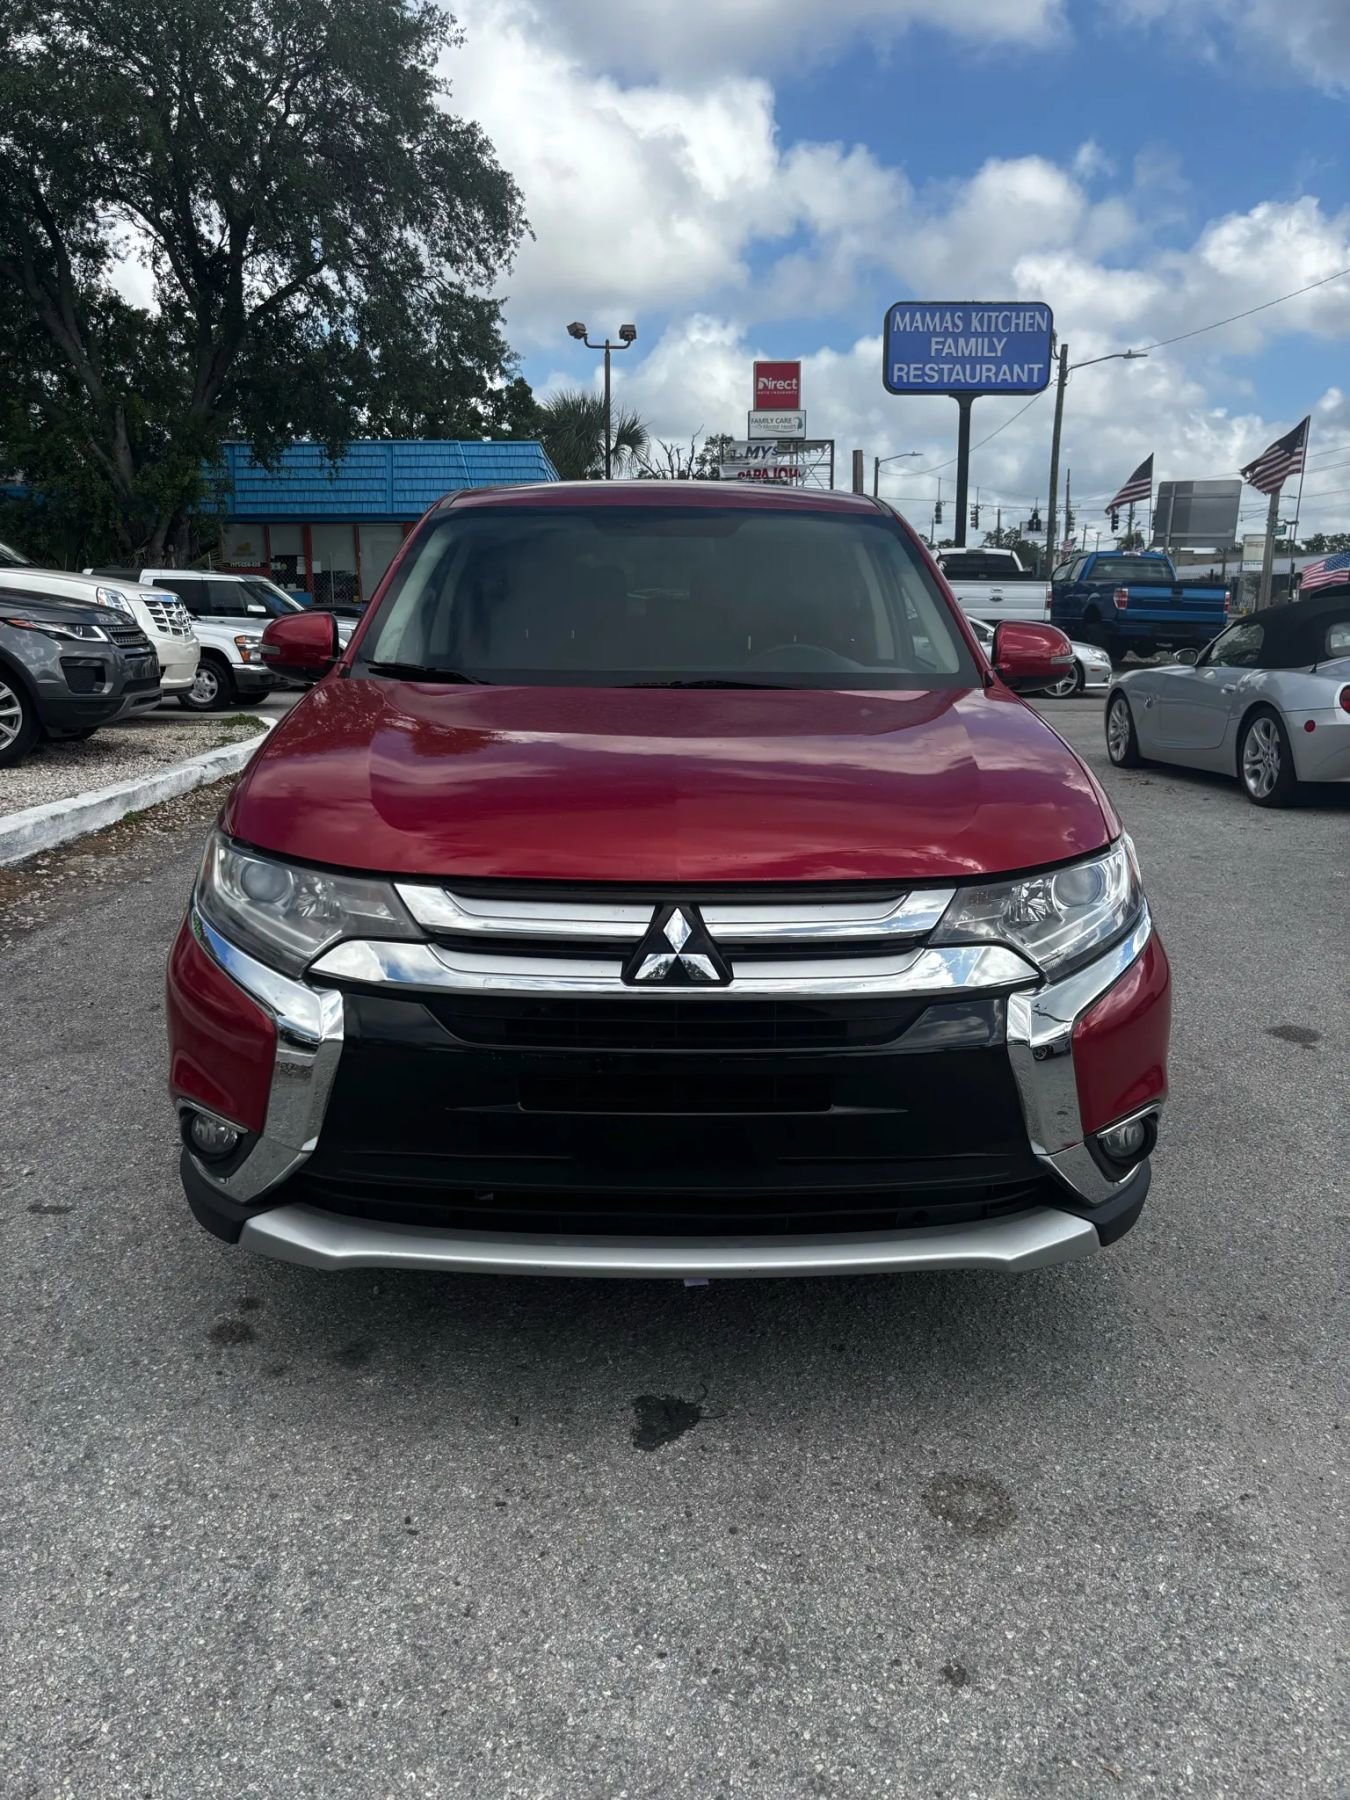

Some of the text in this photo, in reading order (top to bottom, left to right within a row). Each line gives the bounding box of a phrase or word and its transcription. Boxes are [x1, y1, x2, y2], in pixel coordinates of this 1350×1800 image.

[894, 311, 1047, 332] MAMAS KITCHEN
[930, 337, 1007, 357] FAMILY
[893, 364, 1043, 383] RESTAURANT
[758, 377, 798, 390] Direct
